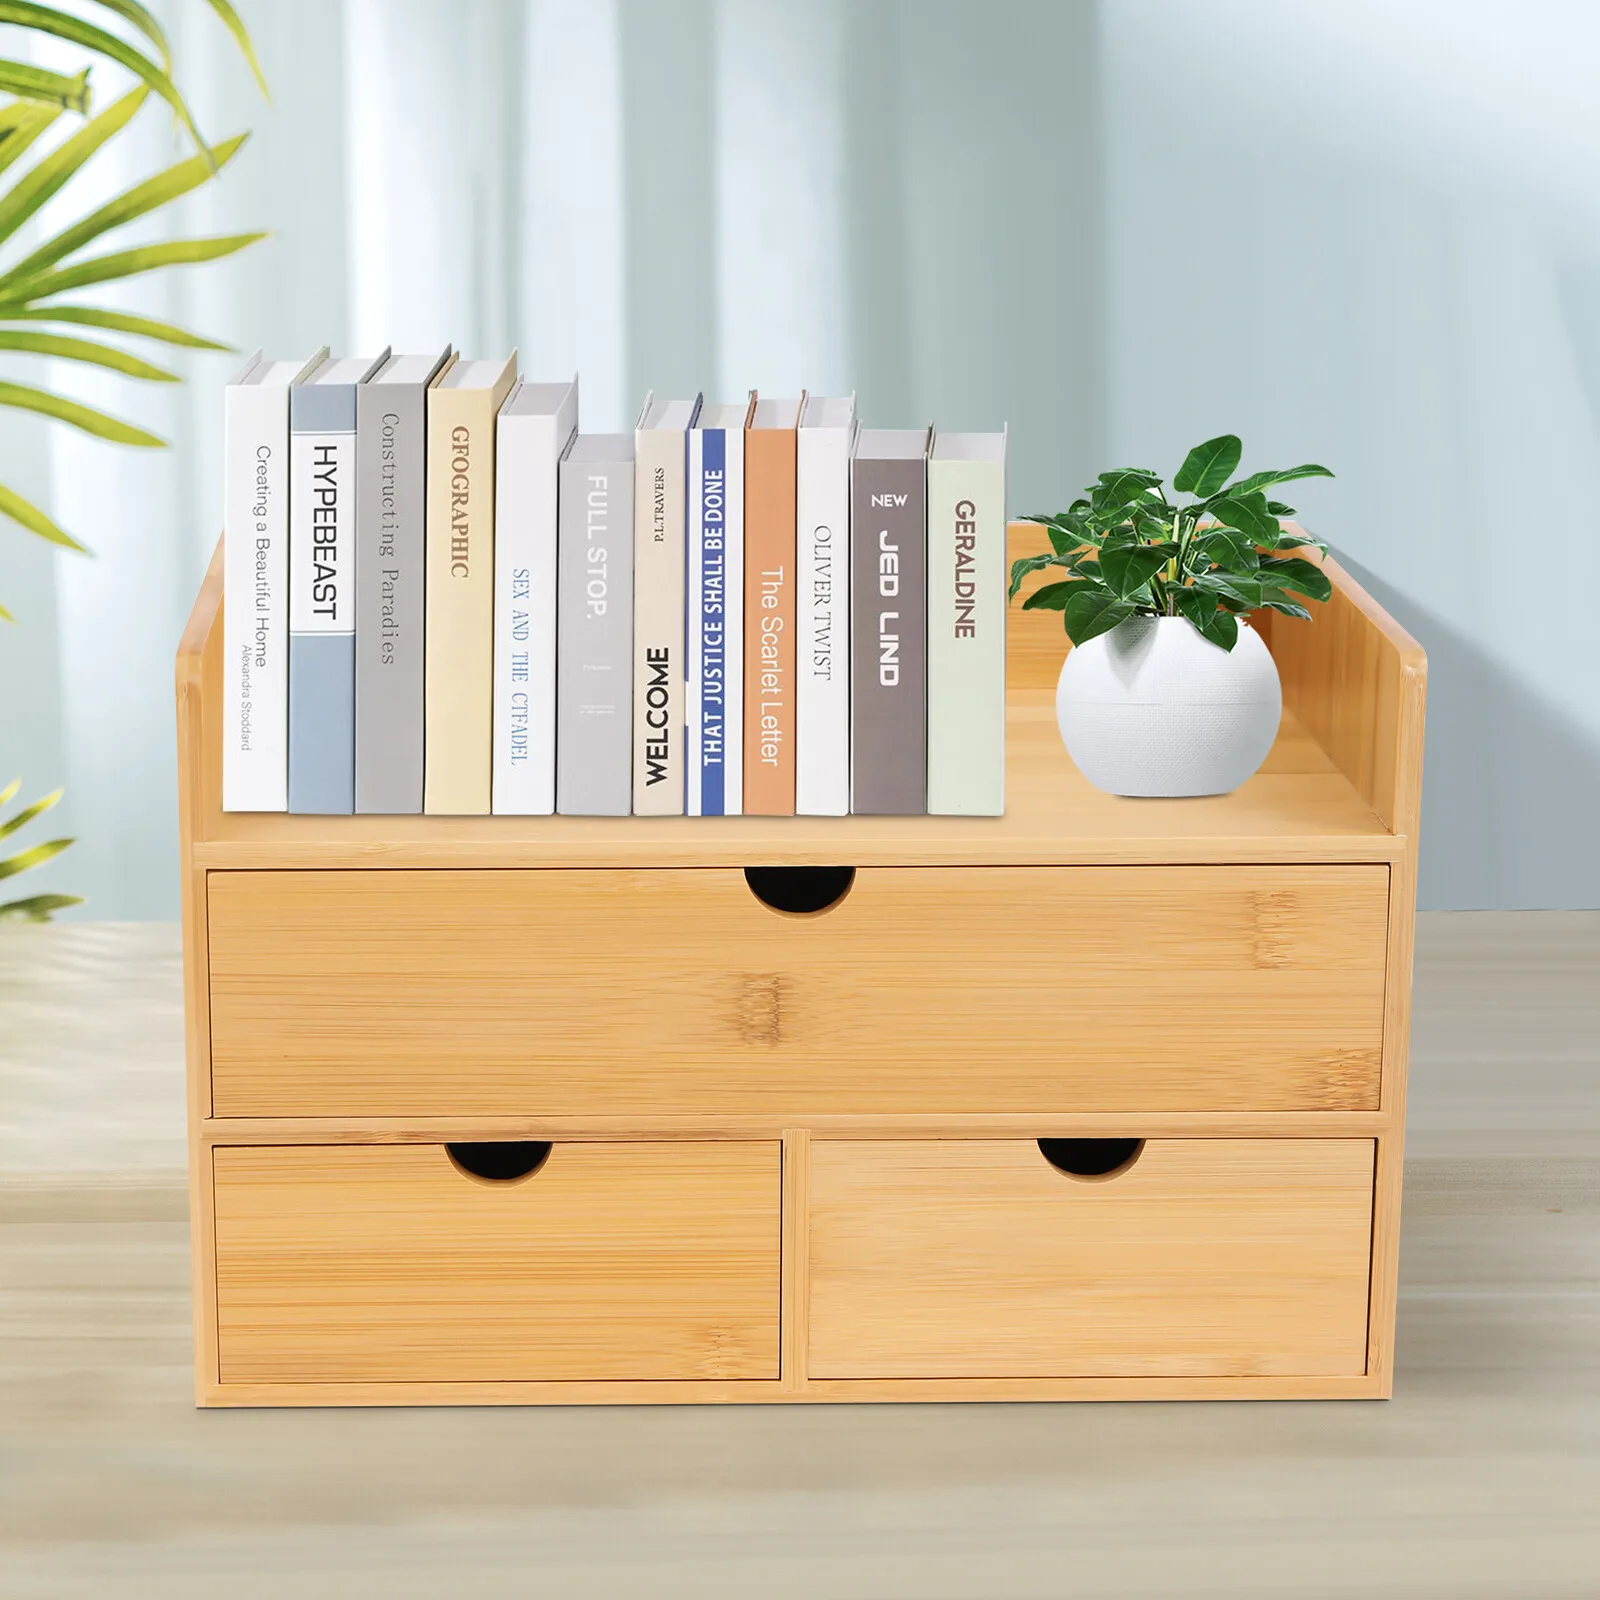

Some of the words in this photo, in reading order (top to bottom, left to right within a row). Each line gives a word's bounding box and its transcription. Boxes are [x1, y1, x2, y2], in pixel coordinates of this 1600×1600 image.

[253, 446, 271, 517] Creating
[378, 413, 400, 557] Constructing
[450, 425, 470, 578] GFOGRAPHIC
[586, 475, 608, 540] FULL
[704, 469, 723, 522] DONE
[871, 493, 908, 508] NEW
[255, 522, 268, 532] a
[312, 445, 338, 621] HYPEBEAST
[704, 527, 723, 550] BE
[255, 538, 271, 612] Beautiful
[512, 568, 530, 599] SEX
[586, 546, 608, 619] STOP.
[703, 554, 723, 614] SHALL
[760, 565, 784, 609] The
[813, 525, 832, 607] OLIVER
[879, 529, 899, 597] JED
[954, 499, 976, 639] GERALDINE
[255, 617, 270, 668] Home
[381, 569, 400, 665] Paradies
[512, 609, 529, 641] AND
[813, 611, 832, 681] TWIST
[879, 611, 900, 687] LIND
[241, 644, 253, 699] Alexandra
[511, 651, 529, 683] THE
[703, 621, 723, 705] JUSTICE
[760, 616, 784, 695] Scarlet
[240, 701, 253, 751] Stoddard
[645, 647, 669, 787] WELCOME
[703, 711, 723, 767] THAT
[760, 701, 784, 767] Letter
